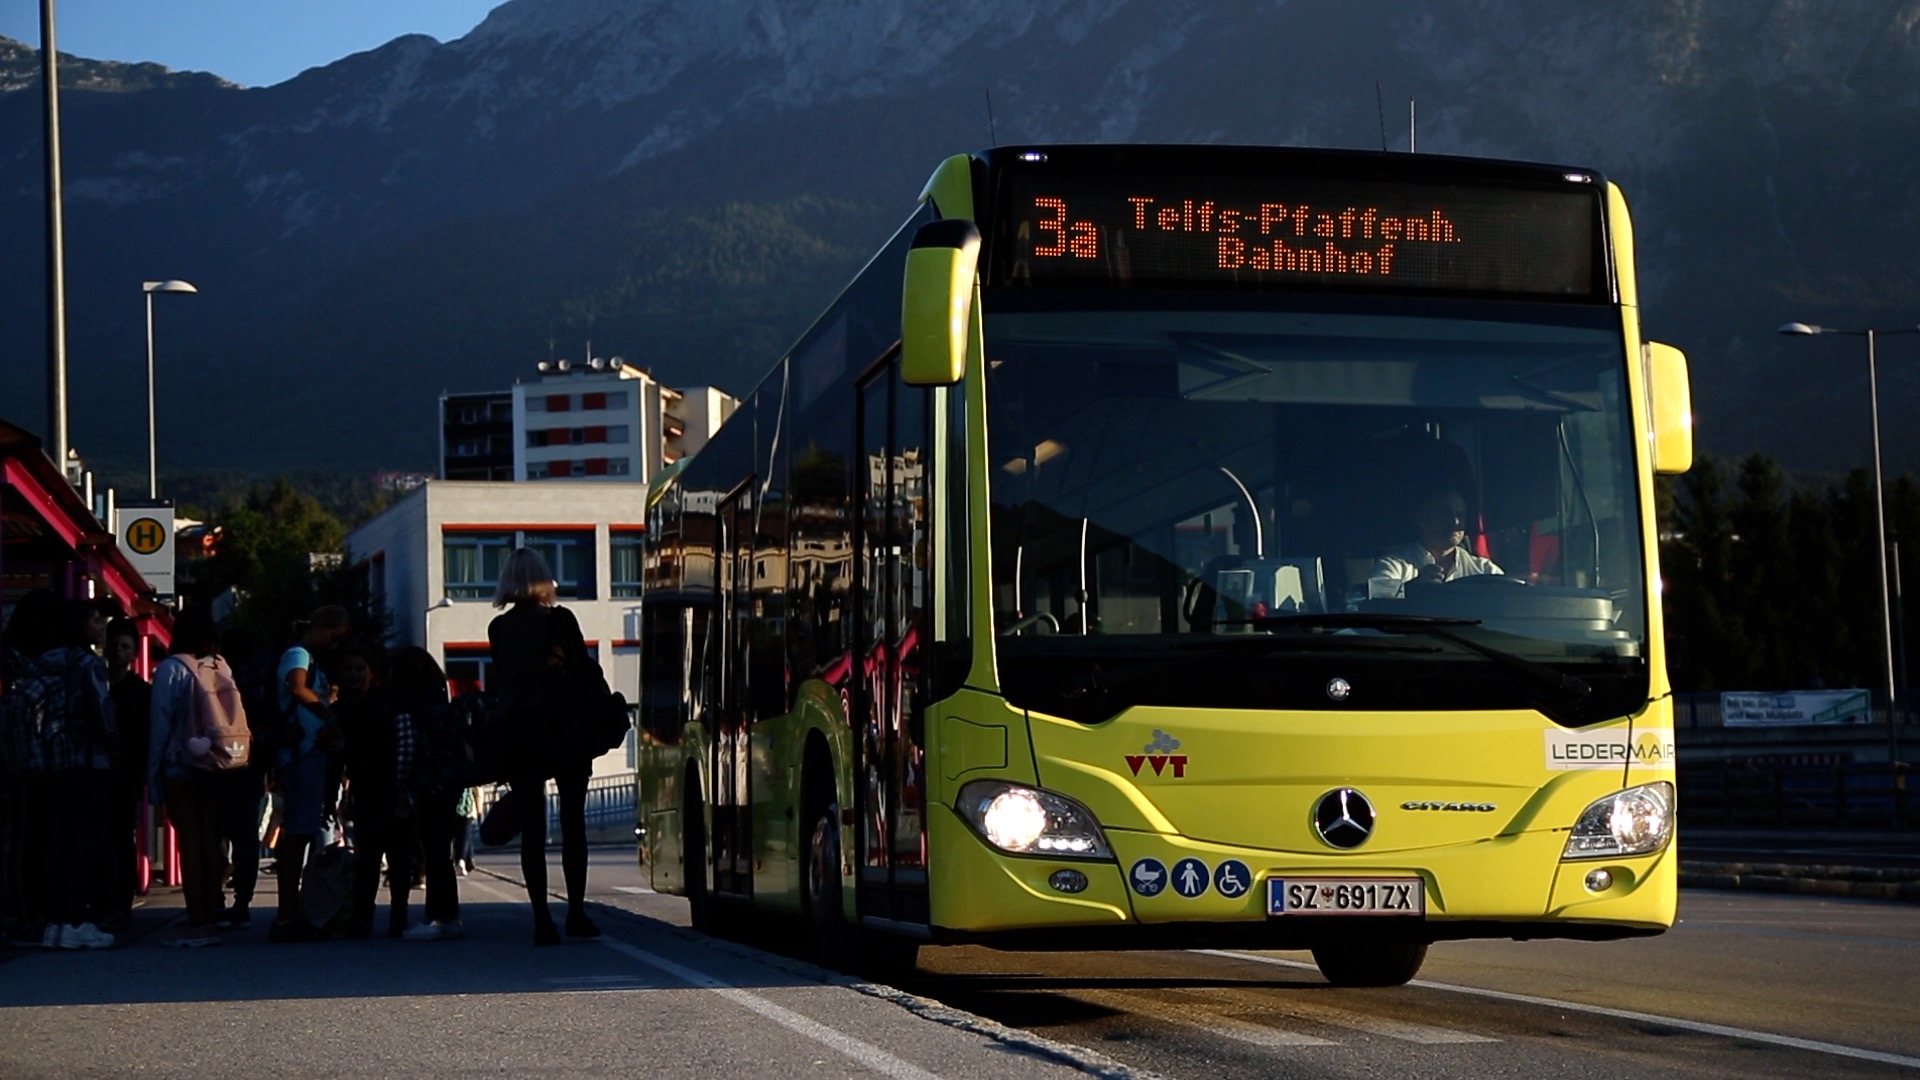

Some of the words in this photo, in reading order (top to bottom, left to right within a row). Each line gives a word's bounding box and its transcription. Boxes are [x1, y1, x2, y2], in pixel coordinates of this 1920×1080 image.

[1034, 196, 1098, 259] 3a
[1127, 196, 1463, 244] Telfs-Pfaffenh.
[1217, 235, 1397, 276] Bahnhof
[136, 525, 155, 547] H
[1552, 743, 1675, 760] LEDERMAIR
[1124, 755, 1189, 779] VVT
[1399, 801, 1497, 813] CITARO
